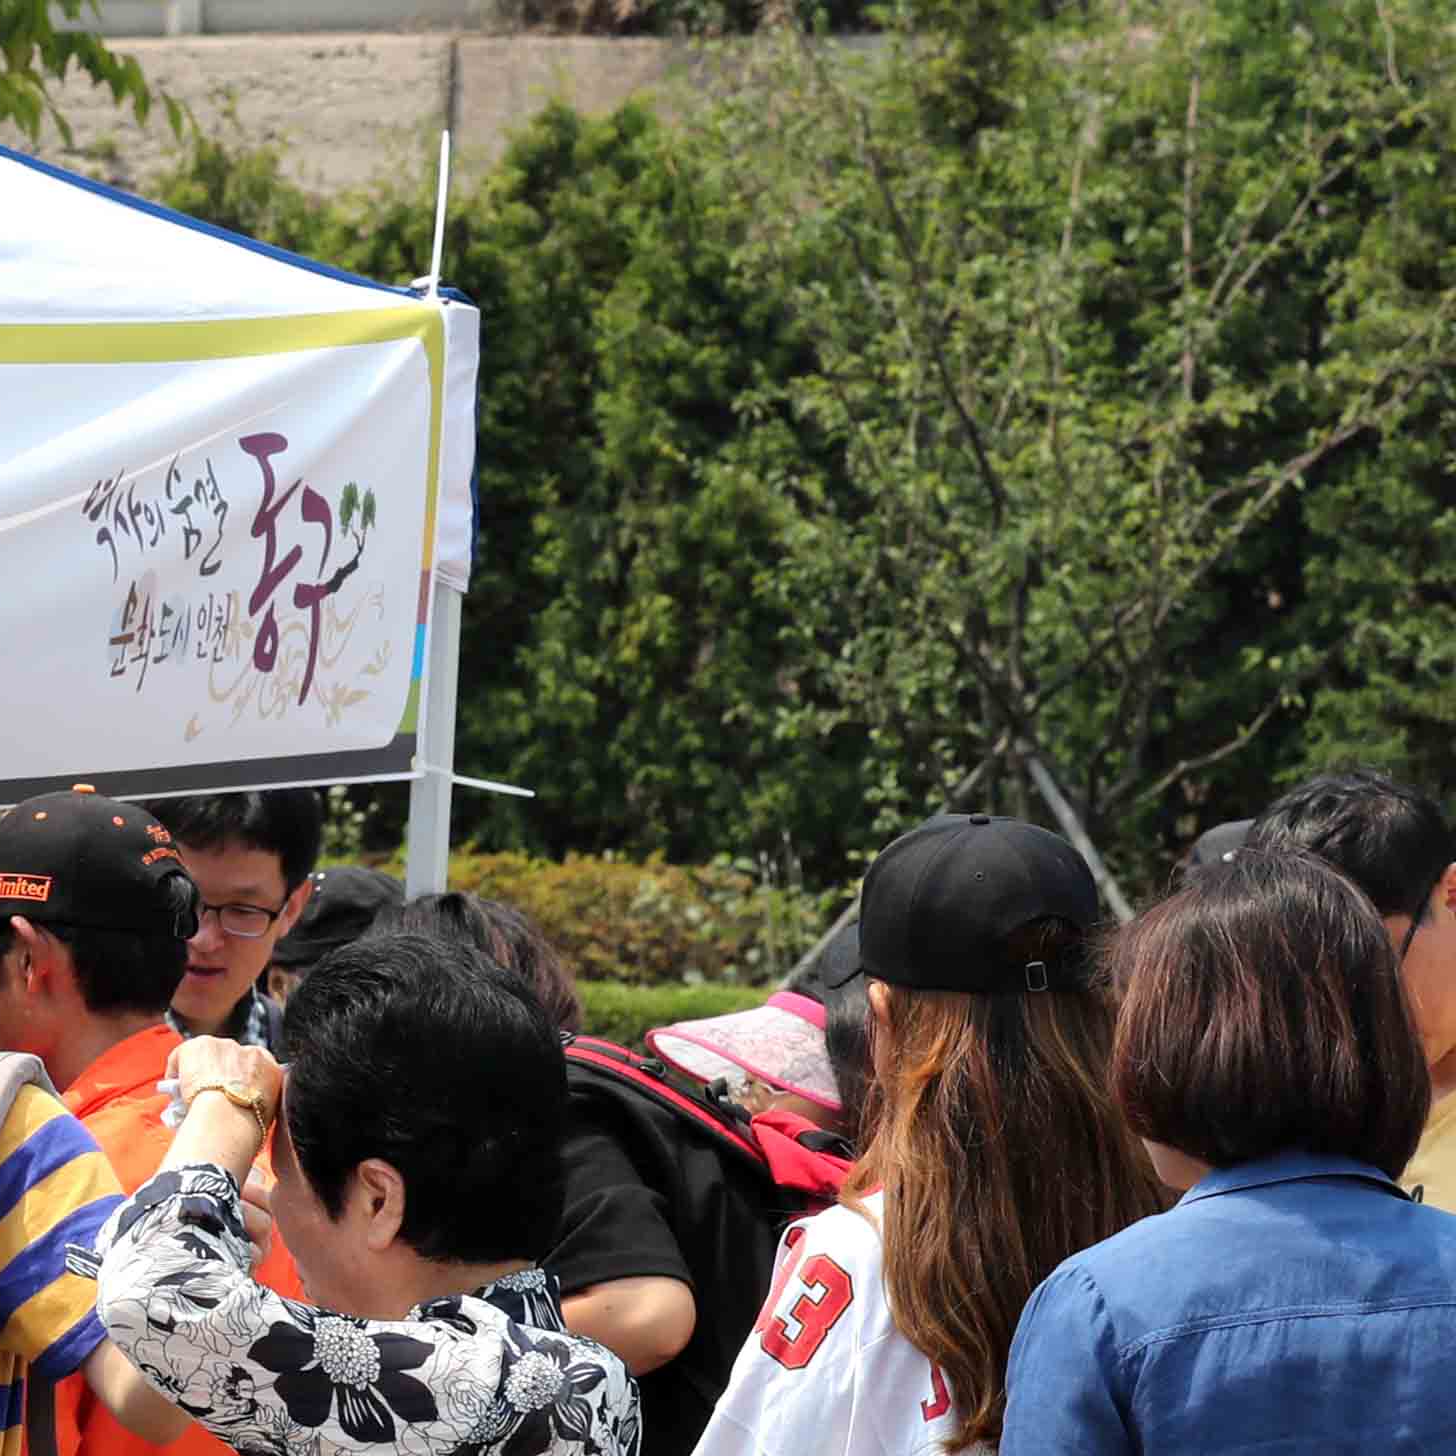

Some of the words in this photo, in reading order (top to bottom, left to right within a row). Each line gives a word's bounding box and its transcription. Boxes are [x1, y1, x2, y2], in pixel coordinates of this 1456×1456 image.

[109, 579, 192, 693] 문화도시
[195, 592, 234, 663] 인천
[238, 431, 335, 707] 동구
